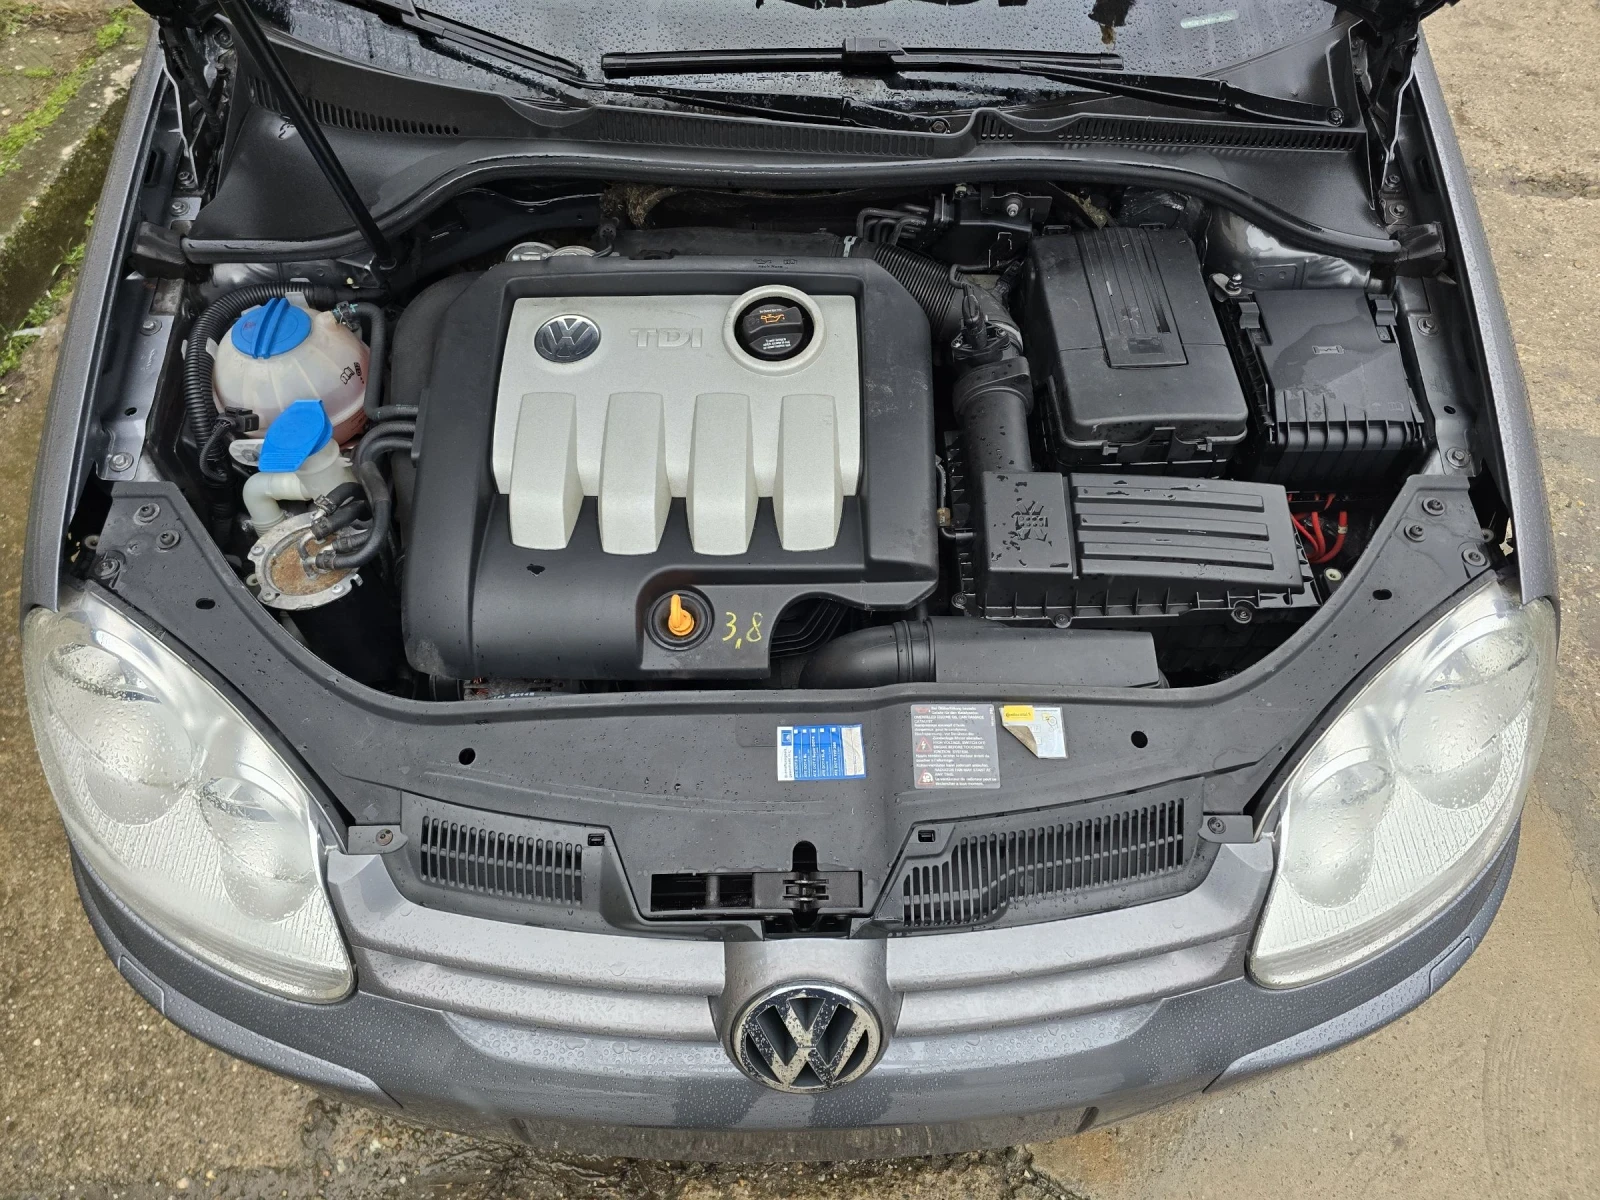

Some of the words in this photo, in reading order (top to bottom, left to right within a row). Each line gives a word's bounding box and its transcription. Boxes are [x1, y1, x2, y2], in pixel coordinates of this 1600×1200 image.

[534, 314, 602, 363] VW
[630, 328, 702, 348] TDI
[722, 611, 764, 649] 3,8
[733, 983, 881, 1094] VW
